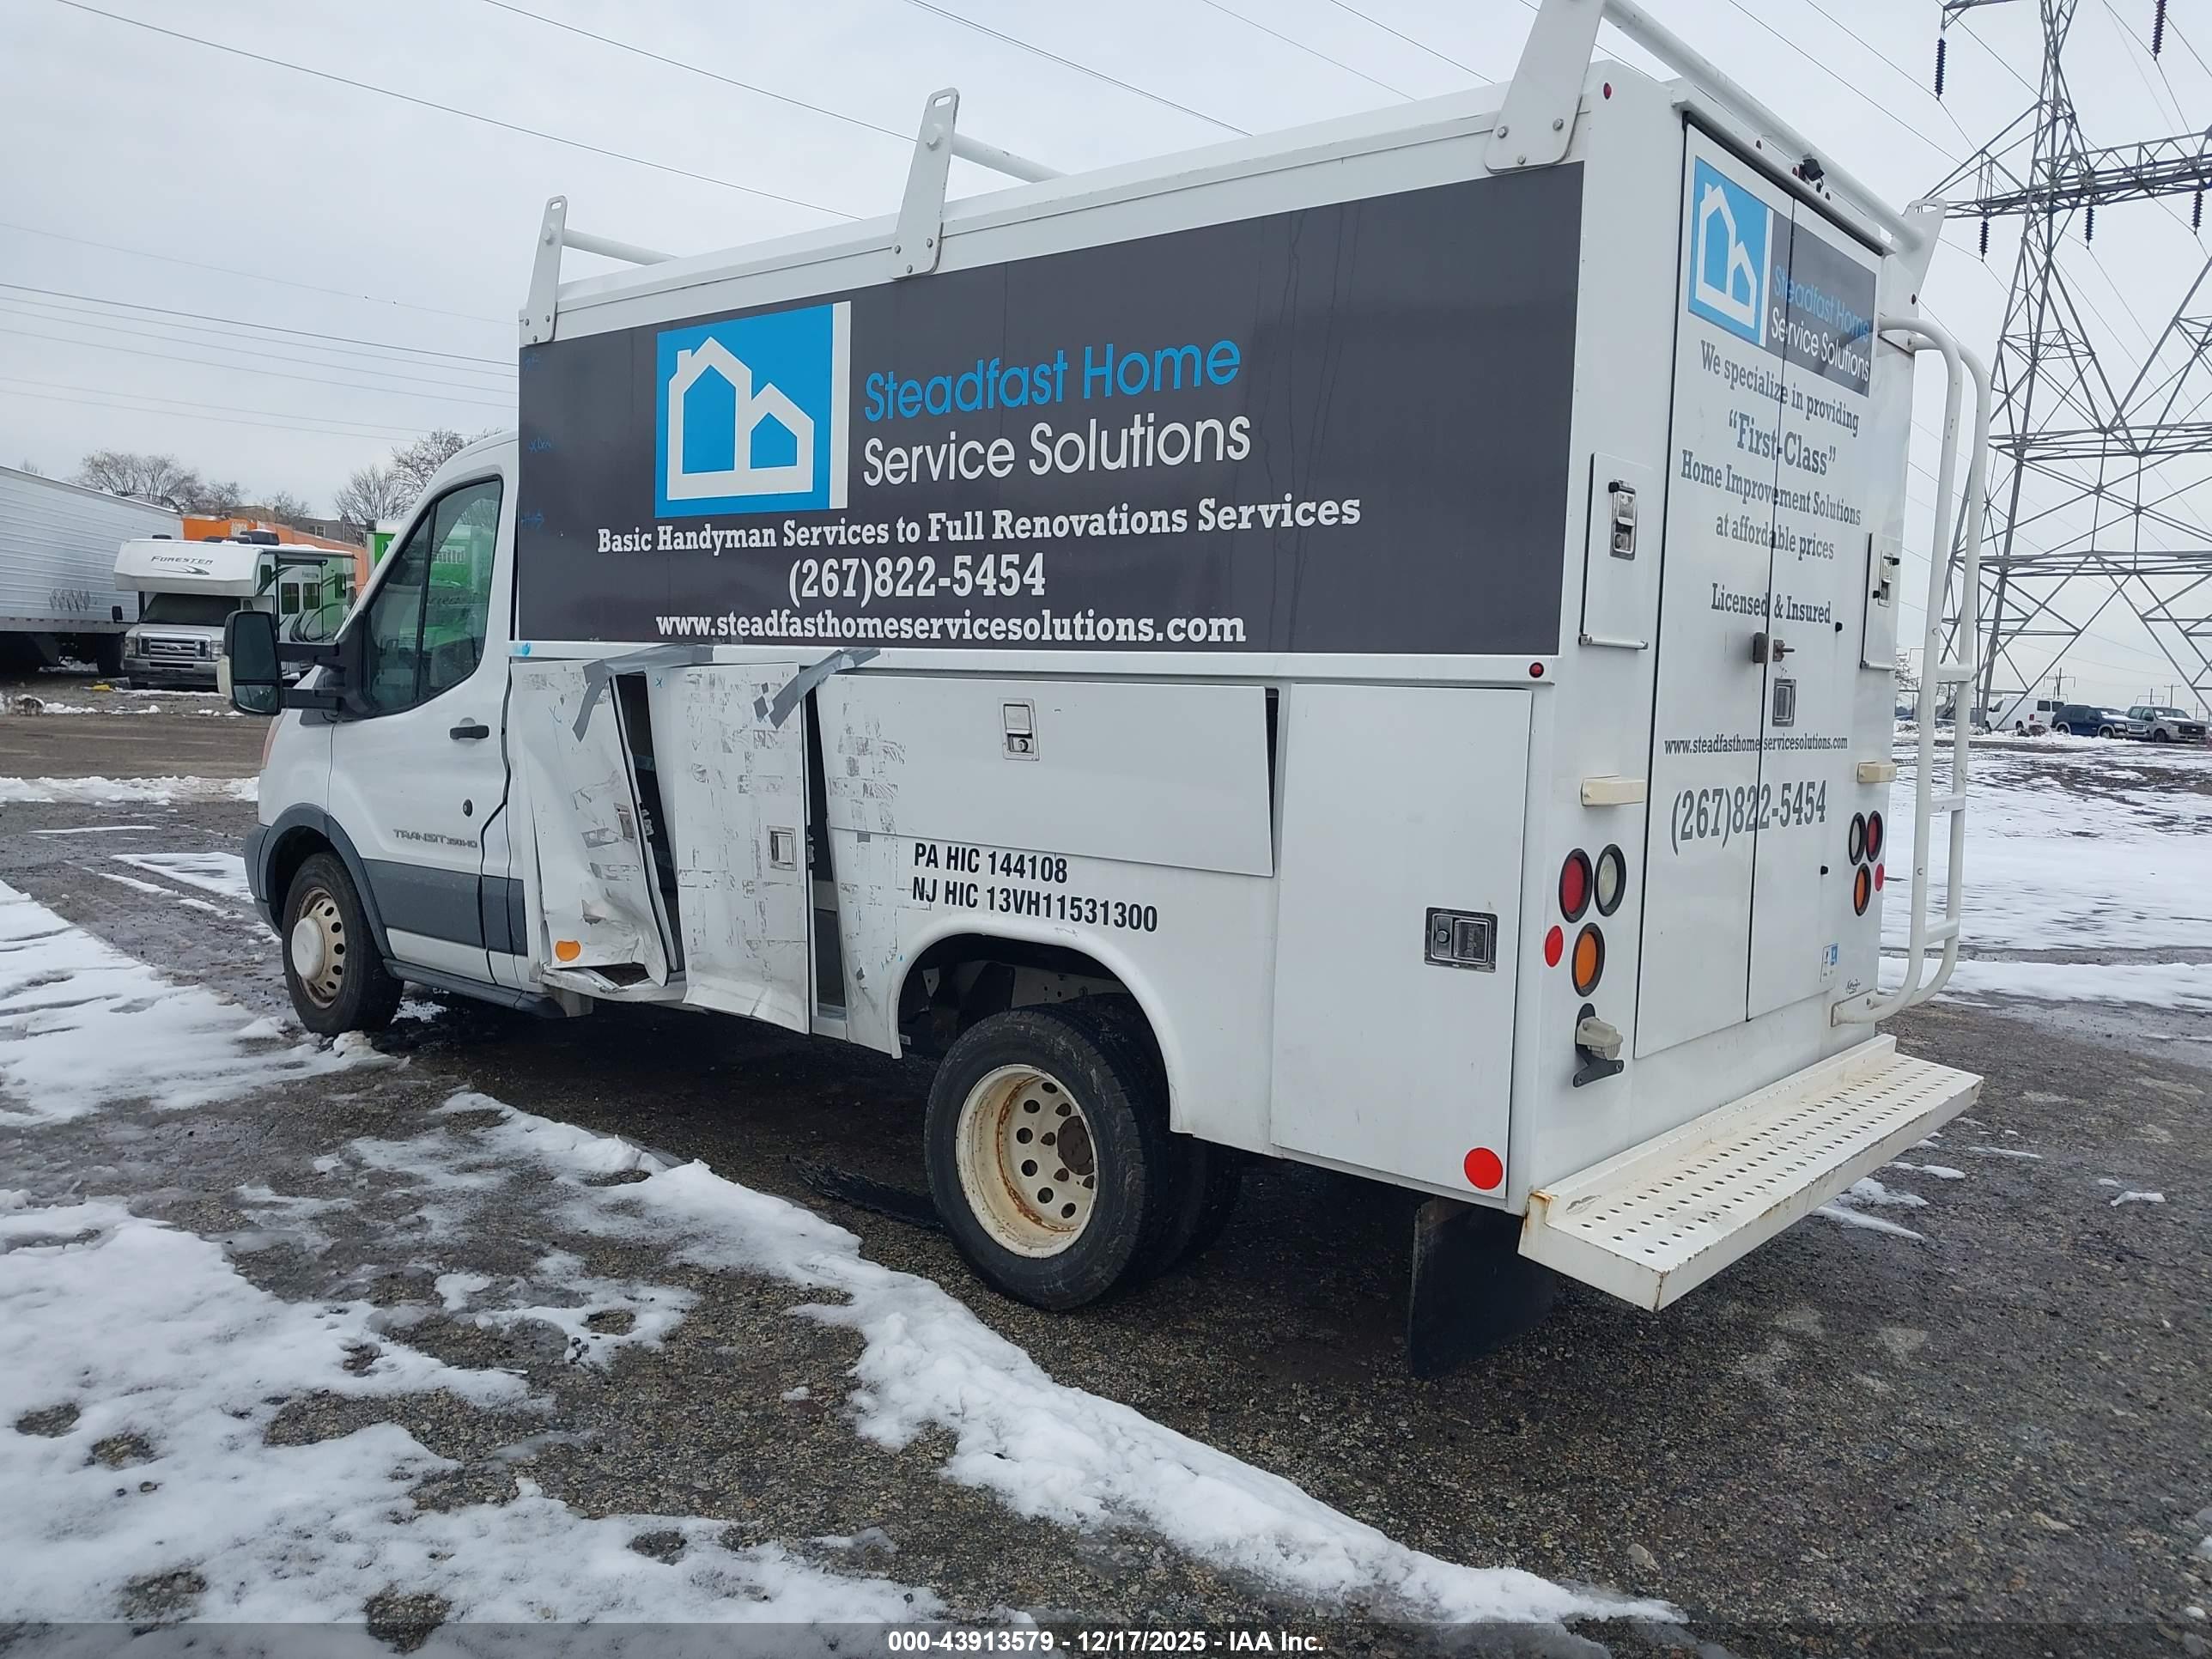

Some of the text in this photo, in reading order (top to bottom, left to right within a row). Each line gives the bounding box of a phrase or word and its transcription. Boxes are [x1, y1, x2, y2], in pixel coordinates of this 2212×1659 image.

[1774, 265, 1870, 343] Steadfast Home
[1771, 306, 1870, 383] Service Solutions
[864, 340, 1241, 422] Steadfast Home
[1700, 340, 1859, 437] We specialize in providing
[863, 412, 1251, 486] Service Solutions
[1680, 449, 1862, 527] Home Improvement Solutions
[597, 492, 1362, 556] Basic Handyman Services to Full Renovations Services
[1715, 513, 1835, 561] at affordable prices
[788, 552, 1046, 608] (267)822-5454
[1711, 582, 1832, 625] Licensed & Insured
[655, 609, 1247, 643] www.steadfasthomeservicesolutions.com
[1664, 732, 1848, 755] www.steadfasthomeservicesolutions.com
[393, 829, 447, 843] TRANSIT
[1671, 780, 1826, 855] (267)822-5454
[914, 842, 1067, 884] PA HIC 144108
[912, 876, 1158, 932] NJ HIC 13VH11531300
